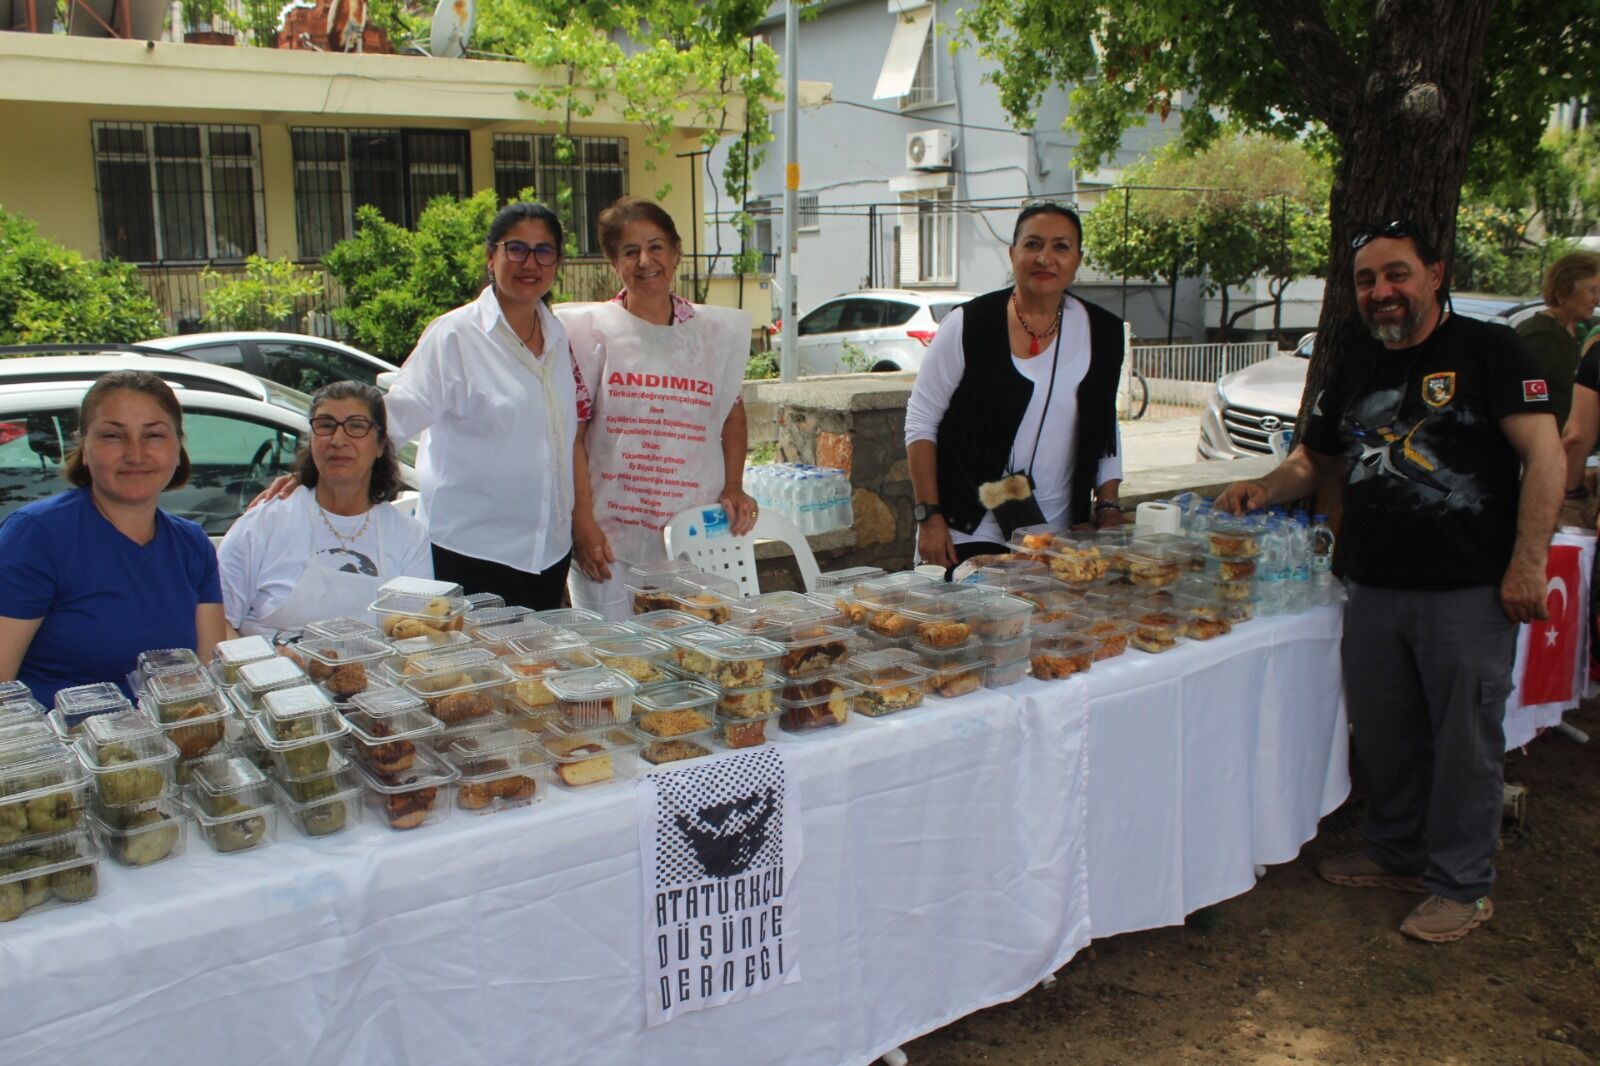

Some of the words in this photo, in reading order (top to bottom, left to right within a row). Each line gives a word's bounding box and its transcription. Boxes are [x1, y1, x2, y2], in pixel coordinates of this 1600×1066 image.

[608, 372, 714, 396] ANDIMIZ!
[656, 860, 783, 927] ATATÜRKÇÜ
[658, 905, 783, 969] DÜŞÜNCE
[660, 938, 783, 1010] DERNEĞİ
